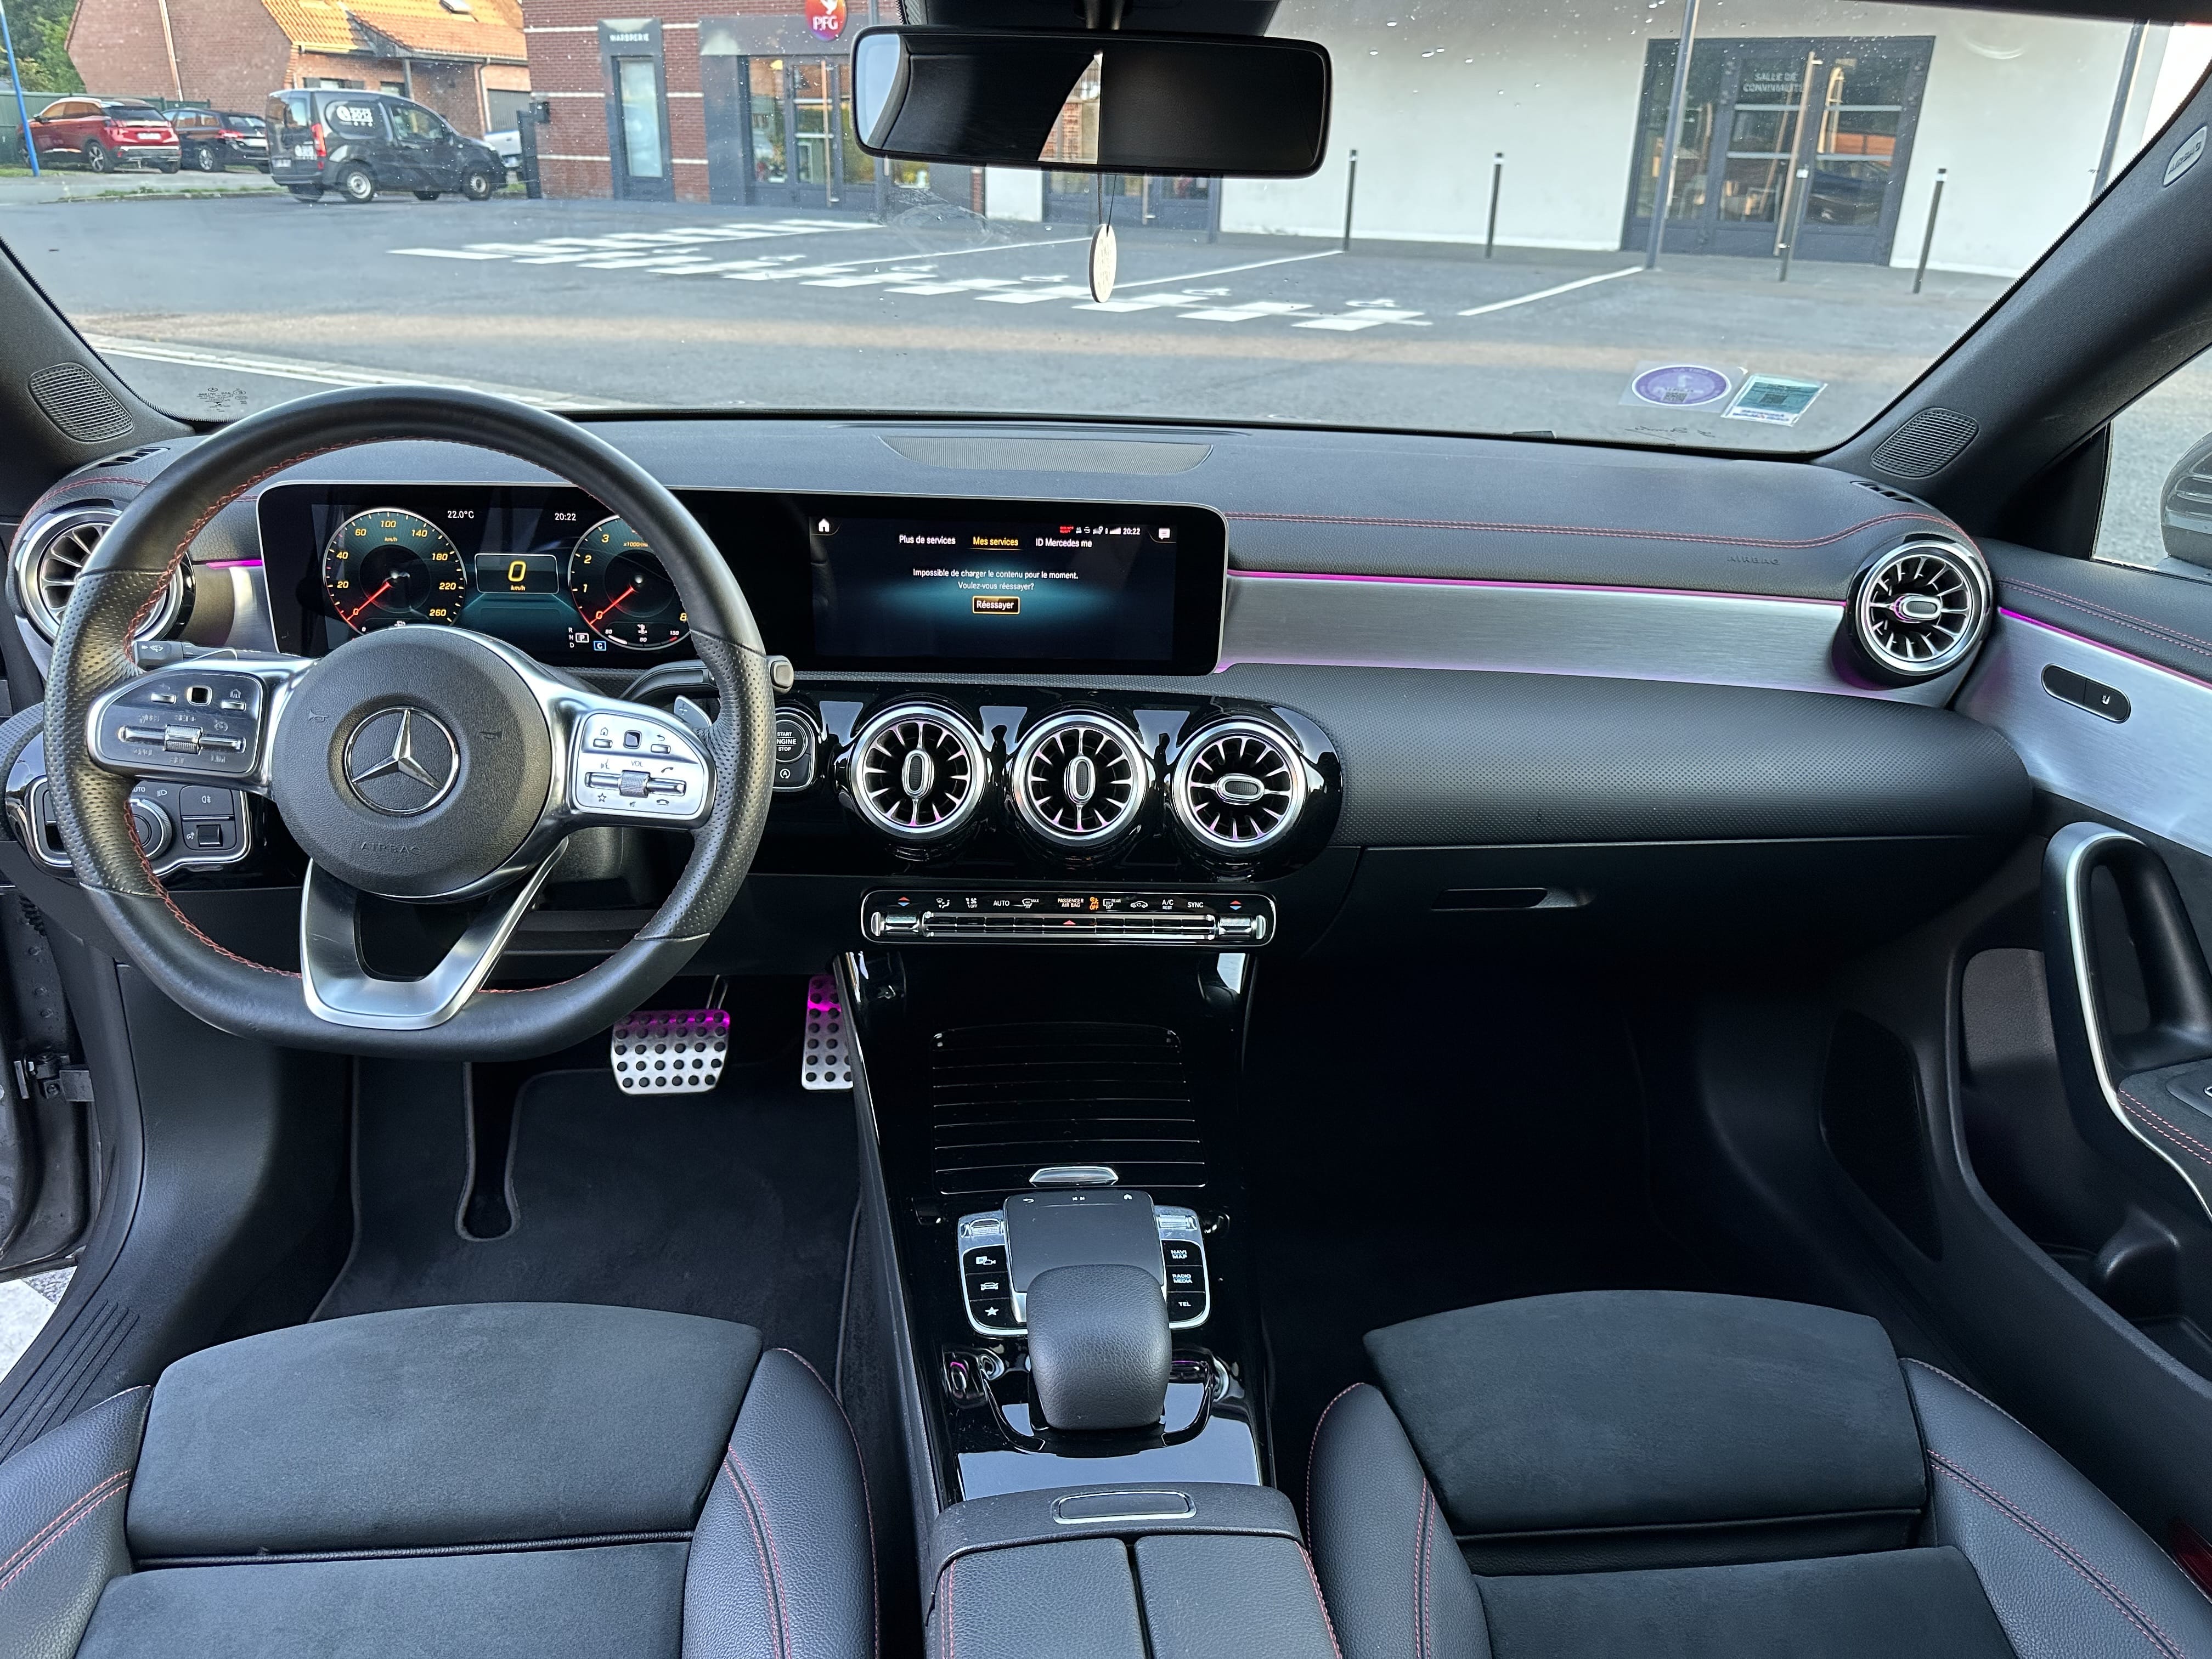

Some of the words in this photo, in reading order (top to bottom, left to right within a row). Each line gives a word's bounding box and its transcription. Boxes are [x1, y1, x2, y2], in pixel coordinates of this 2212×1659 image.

[812, 15, 838, 31] PFG
[1754, 72, 1782, 82] SALLE
[1784, 72, 1797, 82] DE
[447, 510, 475, 519] 22.0°C
[555, 512, 576, 521] 20:22
[355, 528, 366, 537] 60
[1122, 527, 1141, 535] 20:22
[601, 534, 610, 543] 3
[899, 534, 914, 544] Plus
[916, 535, 925, 544] de
[927, 535, 956, 544] services
[973, 536, 988, 545] Mes
[990, 537, 1019, 546] services
[1035, 538, 1043, 546] ID
[1045, 538, 1079, 548] Mercedes
[336, 551, 348, 559] 40
[584, 555, 591, 564] 2
[1728, 555, 1780, 565] AIRBAG
[508, 560, 527, 582] 0
[913, 568, 949, 578] Impossible
[951, 569, 959, 577] de
[961, 569, 986, 579] charger
[439, 582, 456, 590] 220
[583, 584, 588, 593] 1
[1000, 582, 1035, 591] réessayer?
[976, 600, 1014, 610] Réessayer
[595, 611, 603, 619] 0
[360, 842, 421, 855] AIRBAG
